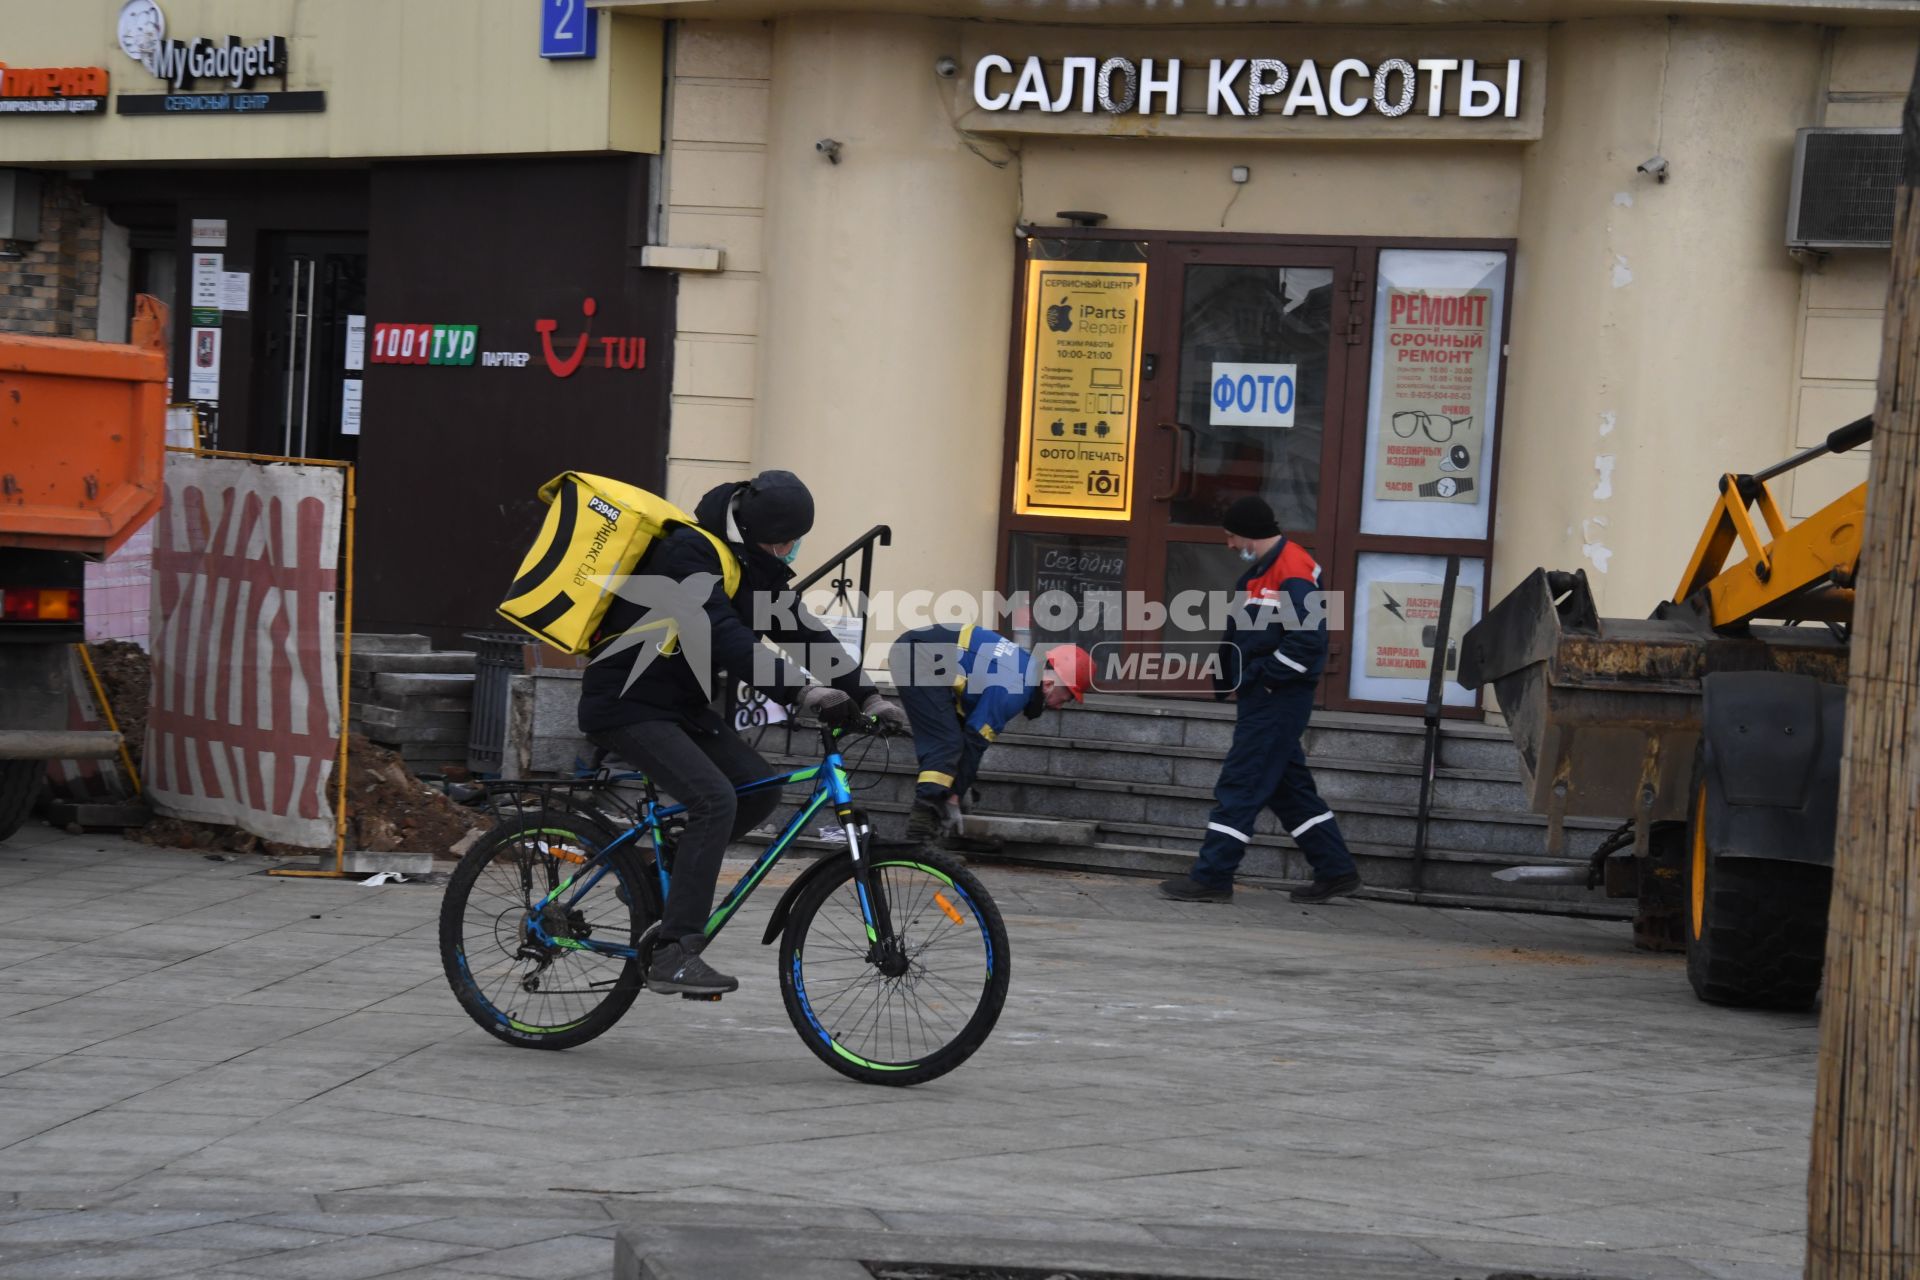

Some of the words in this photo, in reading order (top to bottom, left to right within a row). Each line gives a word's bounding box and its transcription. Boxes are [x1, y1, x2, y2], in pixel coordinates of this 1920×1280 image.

[553, 0, 574, 40] 2
[972, 54, 1177, 115] САЛОН
[1207, 57, 1522, 119] КРАСОТЫ
[233, 95, 270, 112] ЦЕНТР
[1045, 279, 1102, 289] СЕРВИСНЫЙ
[1103, 281, 1134, 289] ЦЕНТР
[1080, 305, 1126, 319] iParts
[1390, 294, 1488, 326] РЕМОНТ
[1079, 321, 1128, 336] Repair
[1390, 332, 1483, 348] СРОЧНЫЙ
[482, 352, 530, 367] ПАРТНЕР
[602, 337, 646, 369] TUI
[1397, 349, 1473, 364] РЕМОНТ
[1213, 374, 1294, 414] ФОТО
[1441, 405, 1471, 415] ОЧКОВ
[1040, 448, 1076, 460] ФОТО
[1080, 451, 1125, 462] ПЕЧАТЬ
[1387, 445, 1442, 457] ЮВЕЛИРНЫХ
[1385, 481, 1413, 492] ЧАСОВ
[585, 518, 618, 563] Яндекс
[1044, 549, 1124, 576] Сегодня
[1407, 597, 1441, 608] ЛАЗЕРН
[1376, 646, 1420, 657] ЗАПРАВКА
